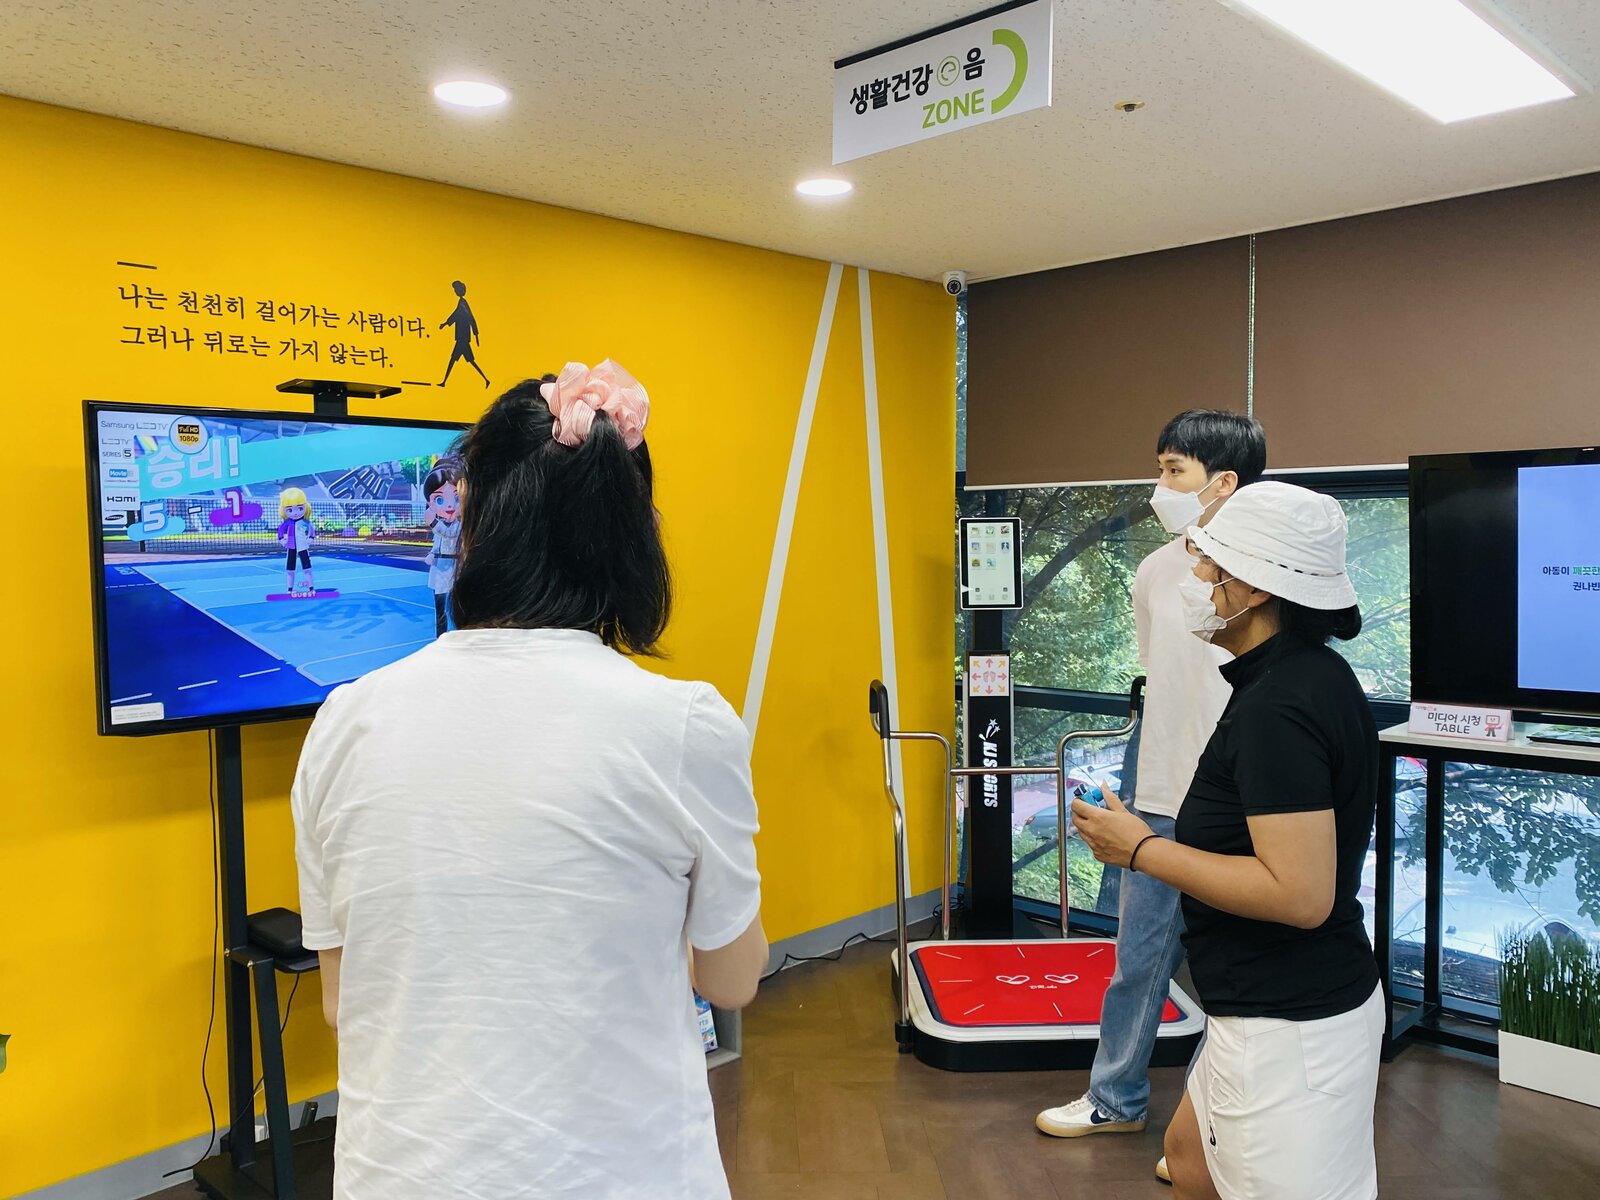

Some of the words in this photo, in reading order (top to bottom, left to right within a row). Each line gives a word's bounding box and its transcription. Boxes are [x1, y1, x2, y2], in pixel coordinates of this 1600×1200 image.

[922, 88, 985, 129] ZONE
[118, 284, 168, 310] 나는
[178, 291, 245, 320] 천천히
[255, 300, 341, 329] 걸어가는
[347, 310, 430, 339] 사람이다.
[120, 325, 195, 353] 그러나
[204, 331, 271, 357] 뒤로는
[279, 337, 319, 362] 가지
[329, 342, 394, 369] 않는다.
[100, 420, 135, 431] Samsung
[179, 435, 199, 443] 1080p
[123, 449, 132, 458] 5
[146, 436, 241, 489] 승리!
[143, 502, 165, 533] 5
[226, 491, 242, 517] 1
[1427, 712, 1458, 724] 미디어
[1460, 714, 1481, 727] 시청
[1434, 722, 1471, 735] TABLE
[983, 758, 998, 808] SORTS
